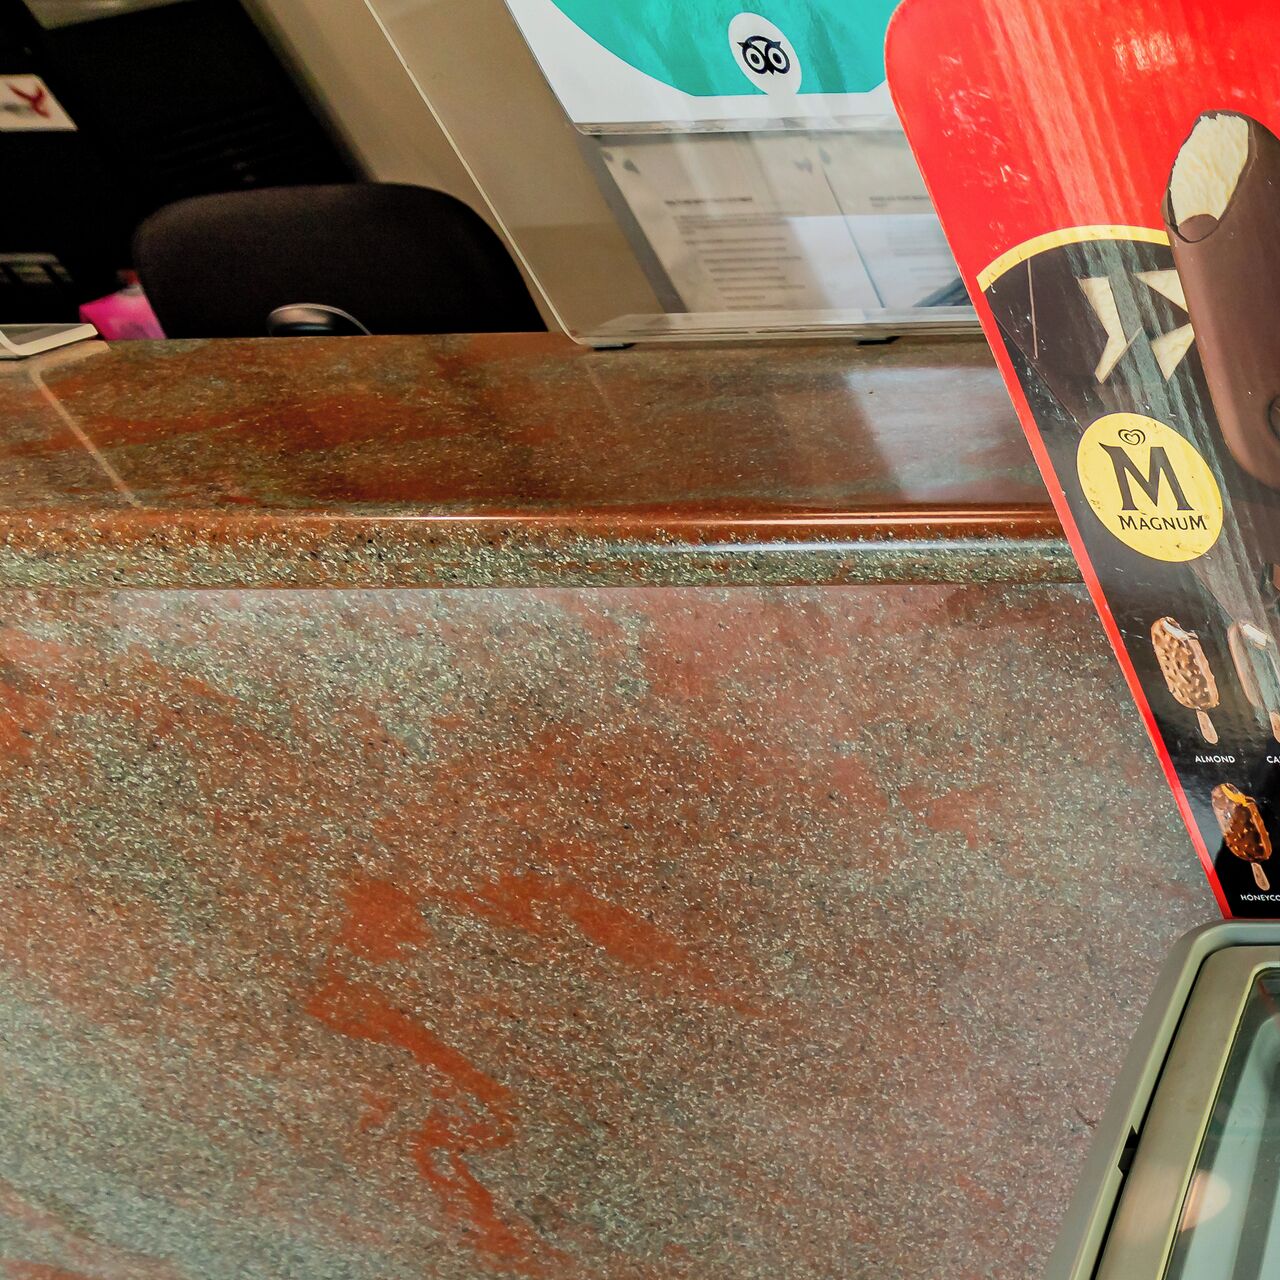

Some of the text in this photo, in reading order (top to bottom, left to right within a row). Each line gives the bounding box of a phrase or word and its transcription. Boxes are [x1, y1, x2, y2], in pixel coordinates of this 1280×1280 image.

[1098, 441, 1195, 511] M
[1117, 514, 1208, 532] MAGNUM
[1194, 755, 1236, 764] ALMOND
